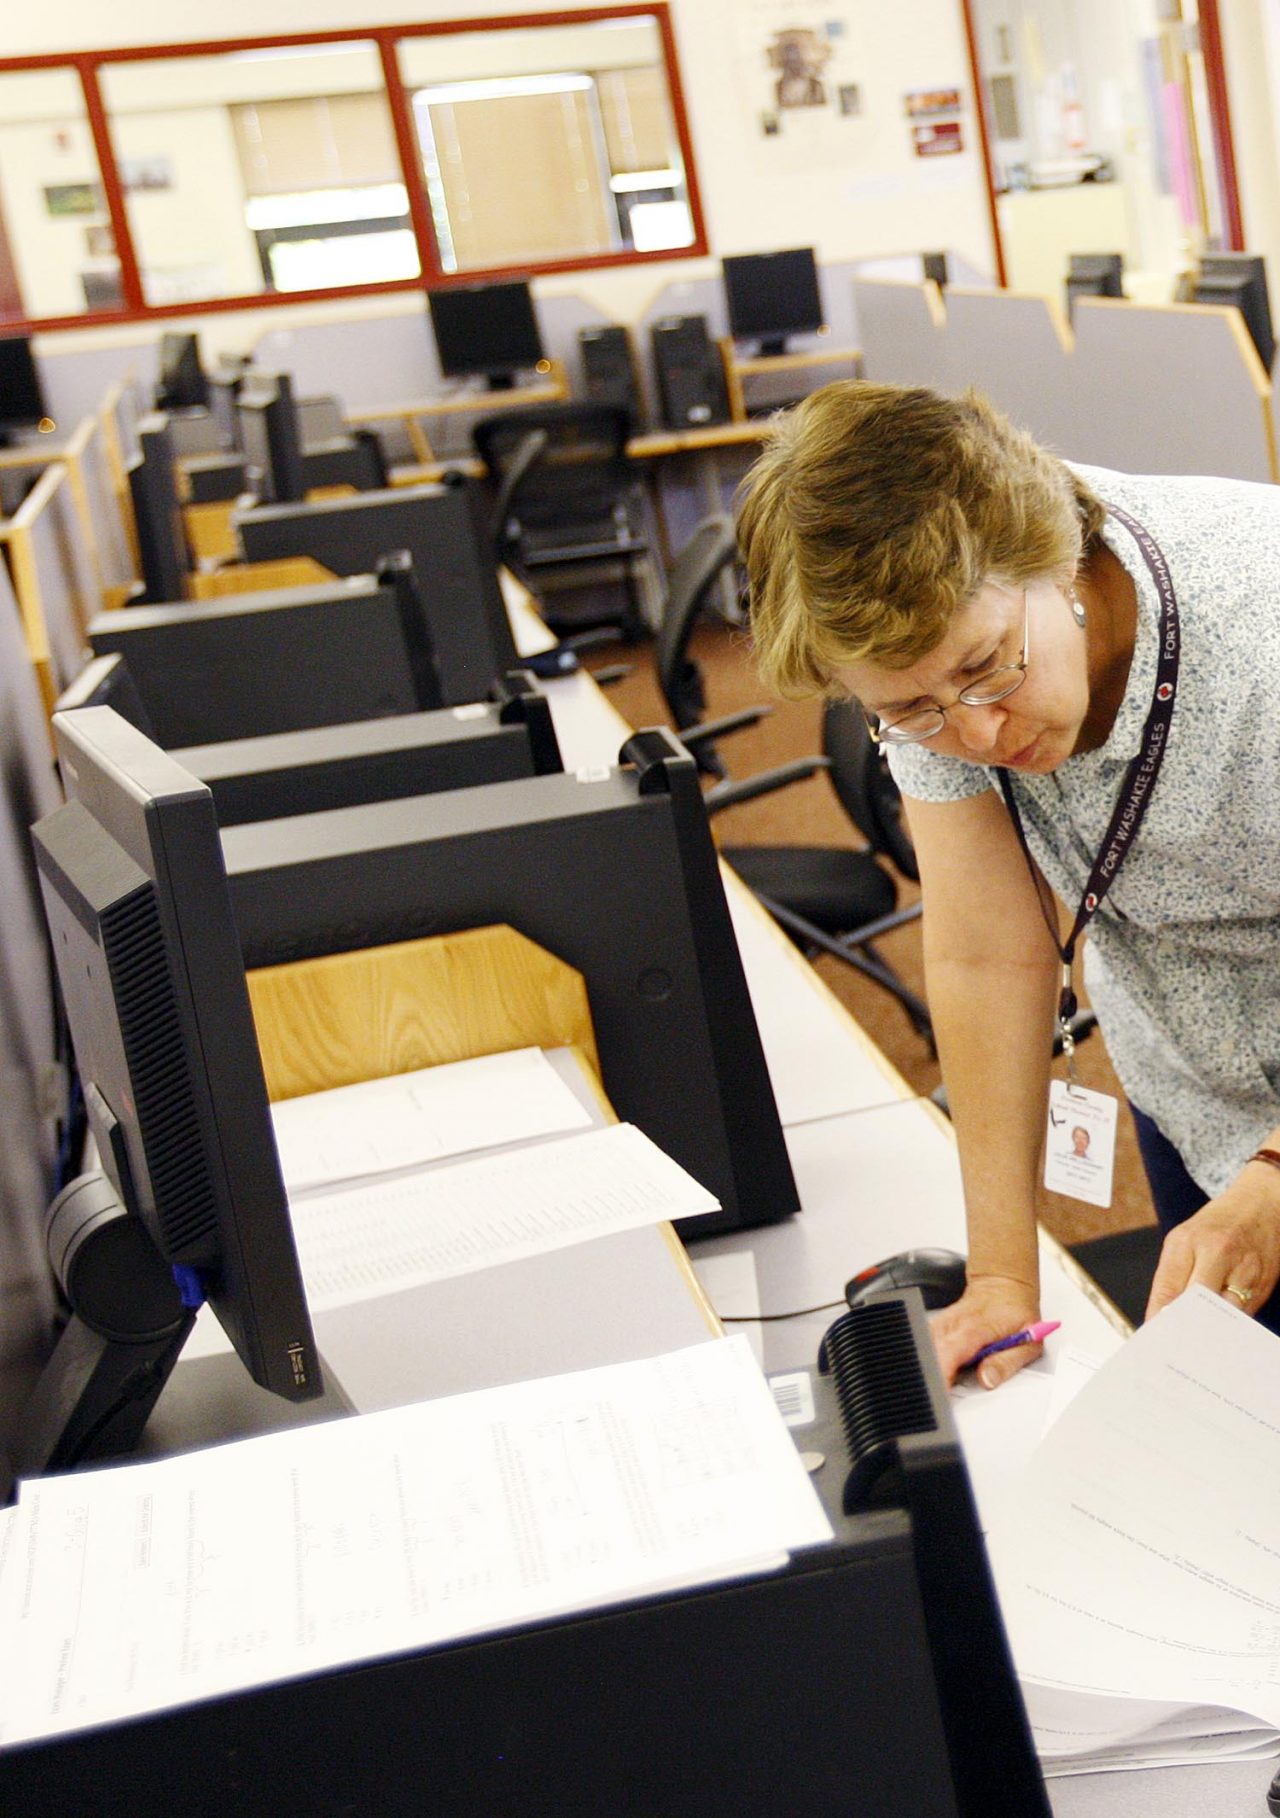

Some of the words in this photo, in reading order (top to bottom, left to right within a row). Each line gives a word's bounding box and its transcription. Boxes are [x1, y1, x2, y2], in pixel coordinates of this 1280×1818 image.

[1140, 537, 1175, 617] WASHAKIE
[1163, 621, 1177, 660] FORT
[1100, 842, 1123, 878] FORT
[1115, 774, 1151, 841] WASHAKIE
[1141, 722, 1165, 773] EAGLES
